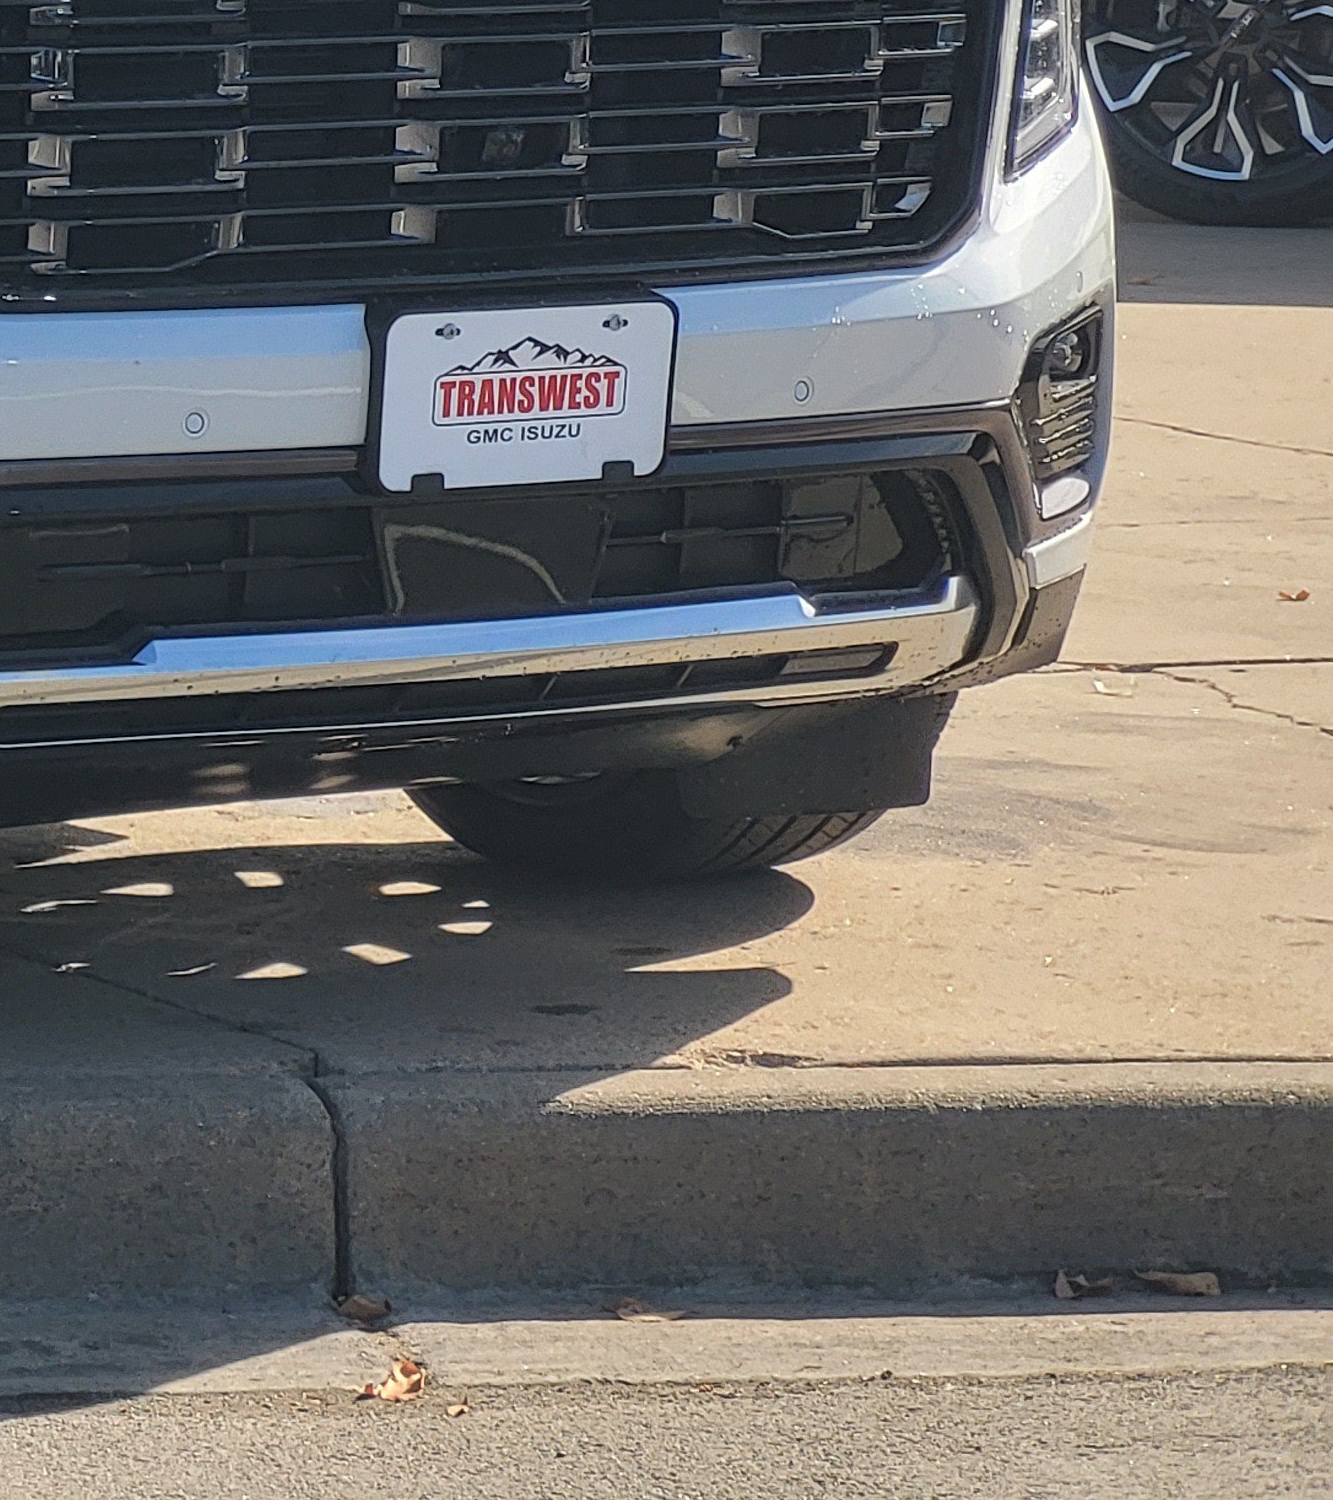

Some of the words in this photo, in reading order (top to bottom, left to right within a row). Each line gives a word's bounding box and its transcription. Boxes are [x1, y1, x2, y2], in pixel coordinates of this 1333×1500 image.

[440, 371, 621, 419] TRANSWEST
[466, 426, 514, 445] GMC
[521, 423, 582, 442] ISUZU
